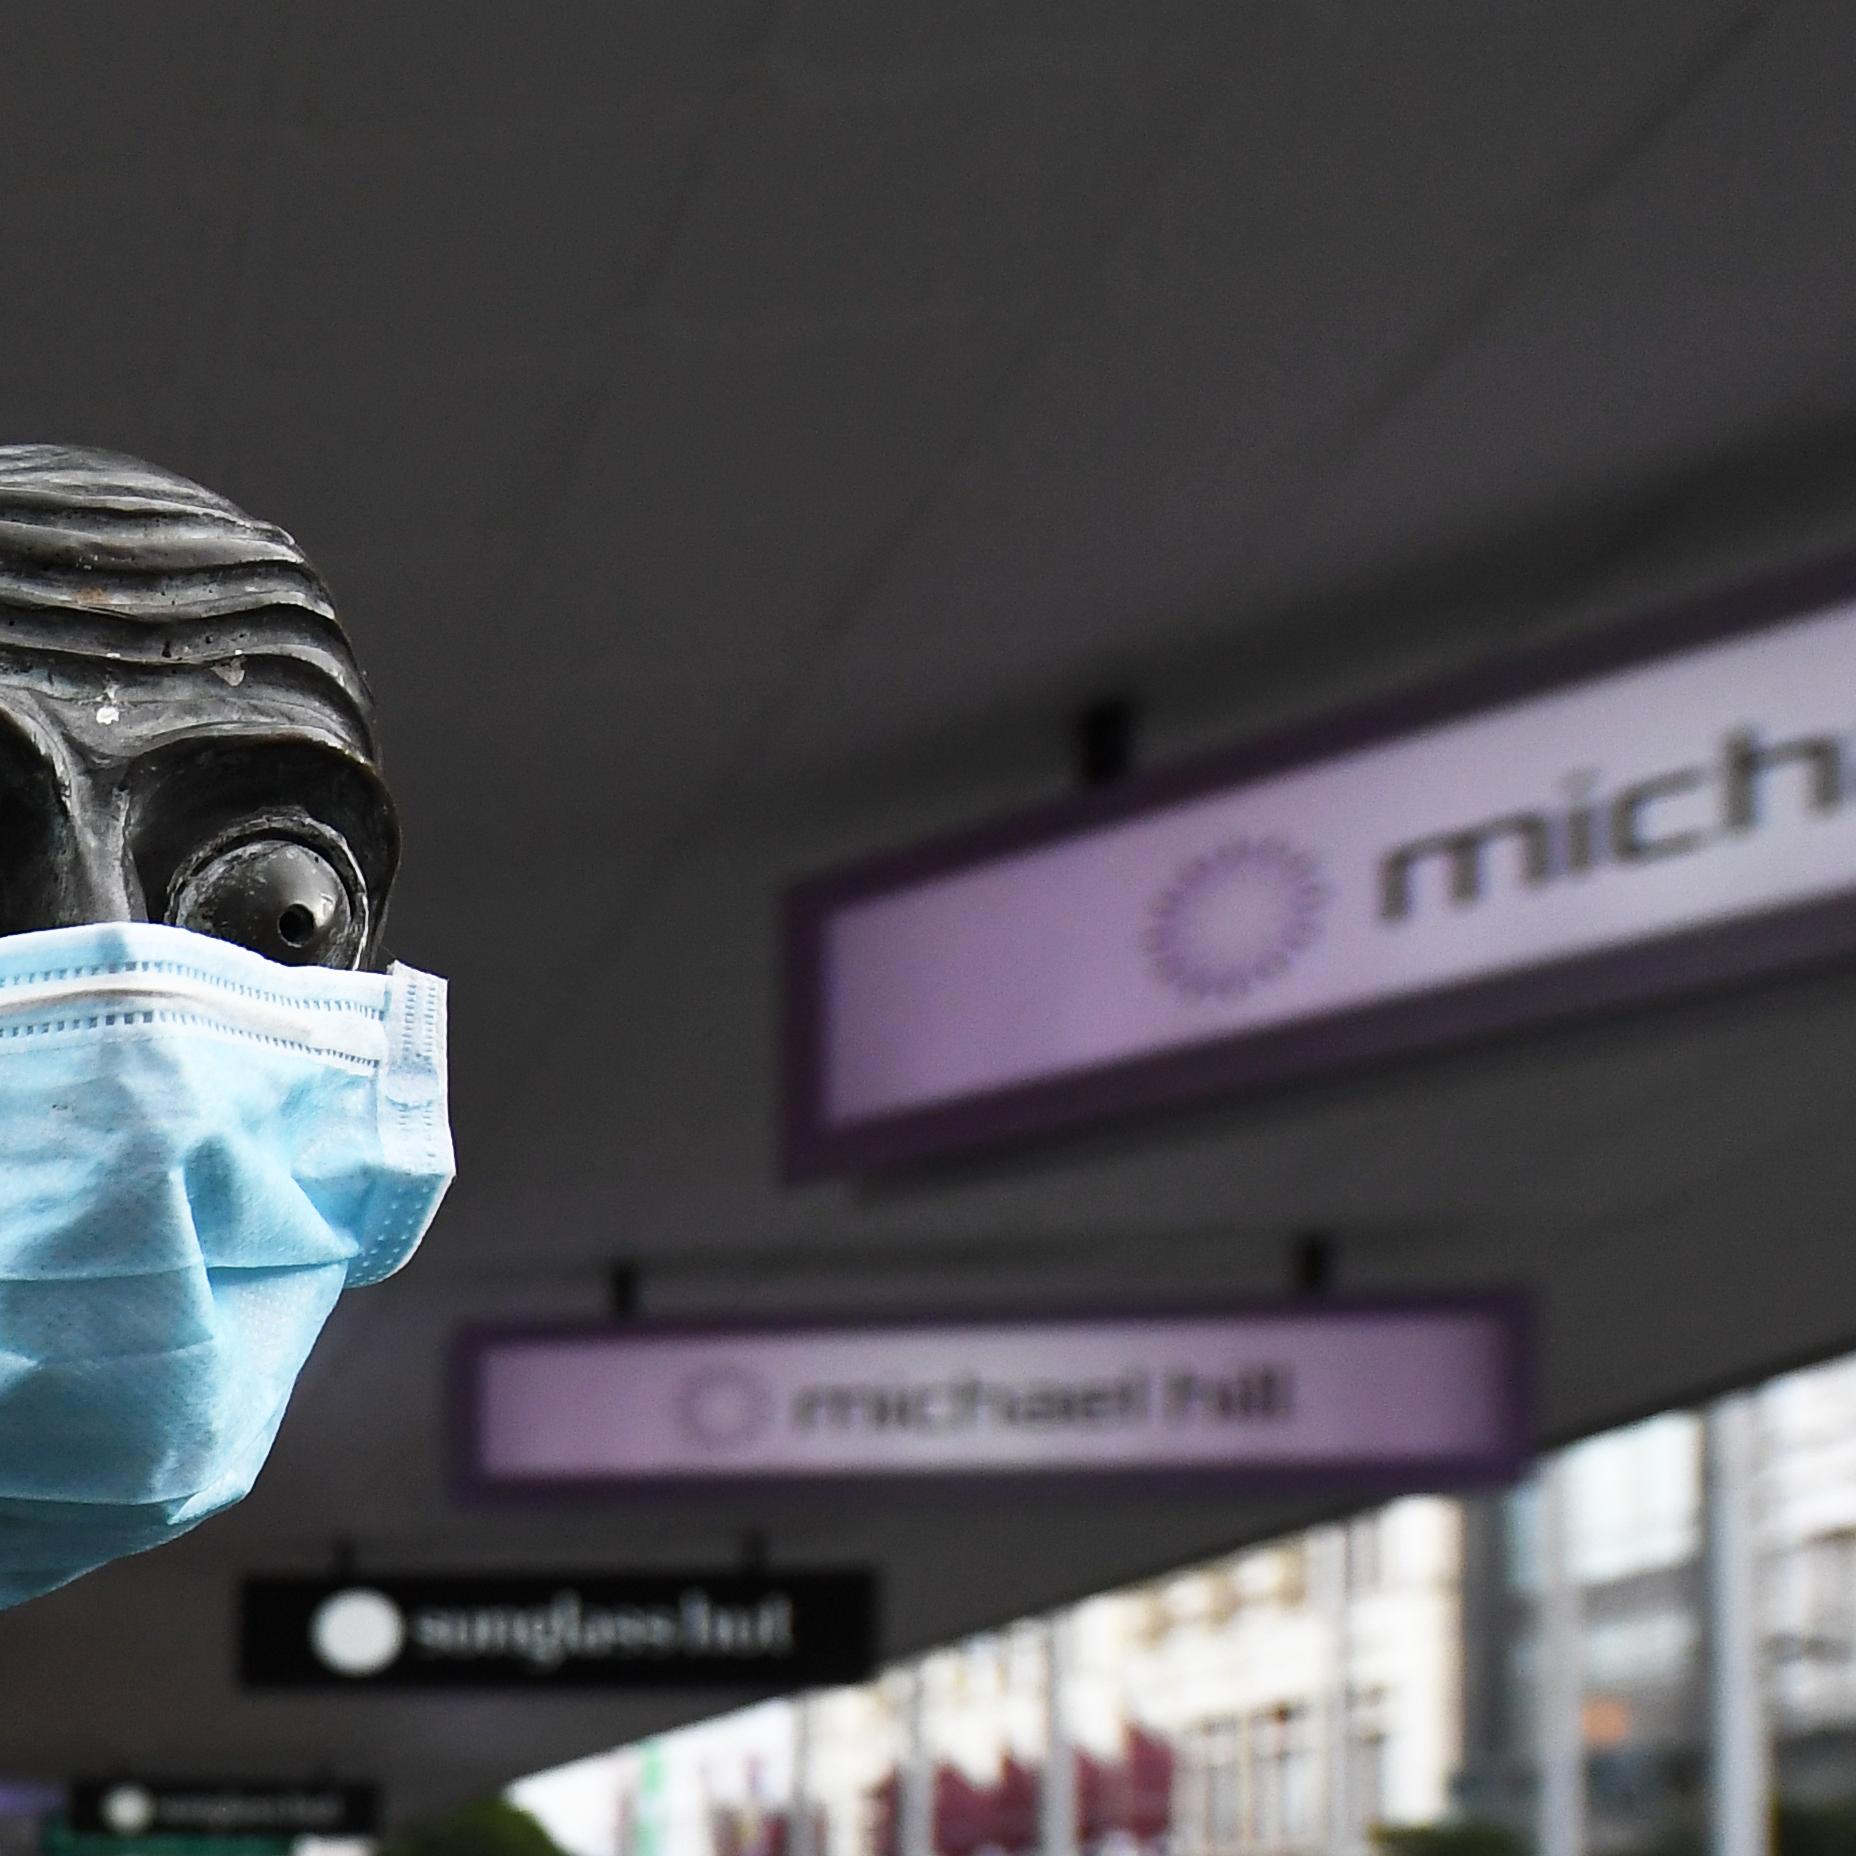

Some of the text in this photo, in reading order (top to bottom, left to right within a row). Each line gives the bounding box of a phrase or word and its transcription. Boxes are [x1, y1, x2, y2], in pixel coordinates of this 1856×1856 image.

[1379, 726, 1856, 924] mich
[792, 1358, 1293, 1432] michael hill
[412, 1590, 677, 1674] sunglass
